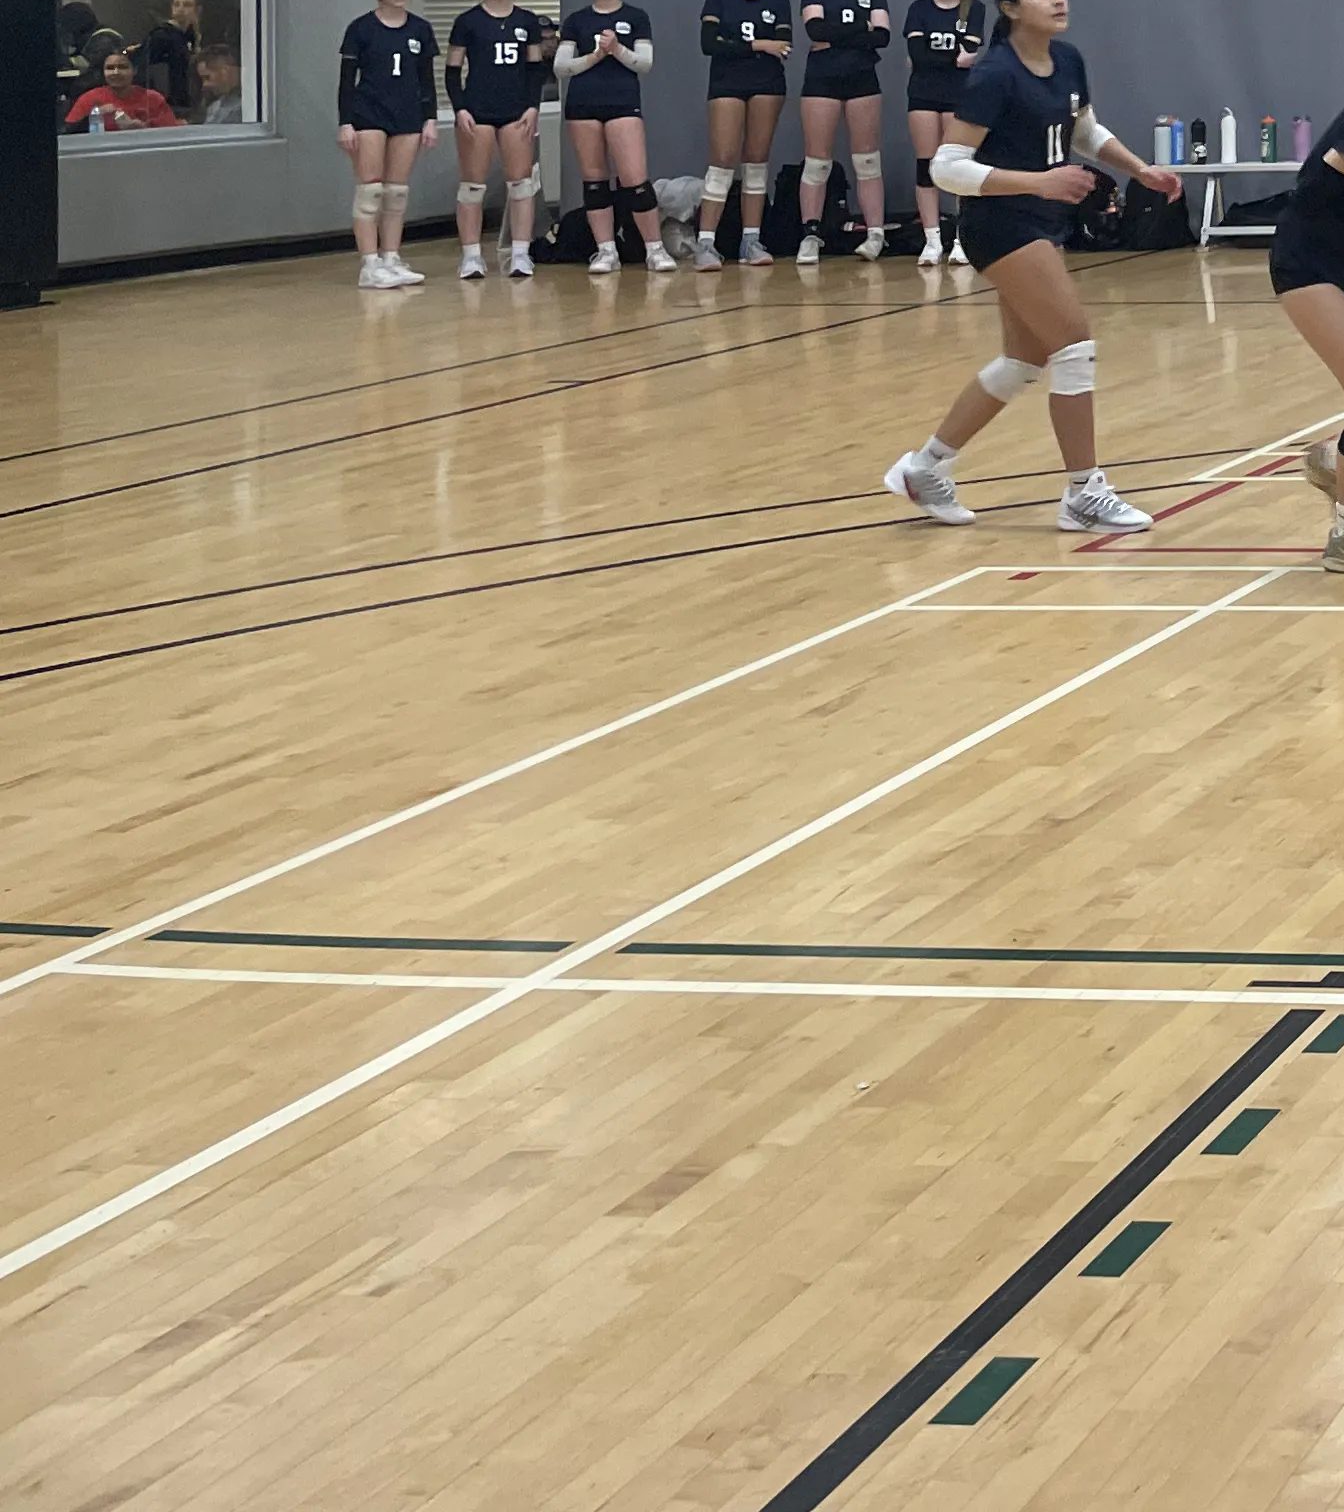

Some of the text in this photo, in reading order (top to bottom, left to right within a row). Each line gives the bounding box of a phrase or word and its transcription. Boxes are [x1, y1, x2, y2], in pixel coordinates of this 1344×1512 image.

[930, 32, 956, 51] 20
[391, 53, 401, 76] 1
[494, 42, 518, 65] 15
[1047, 123, 1064, 165] 11
